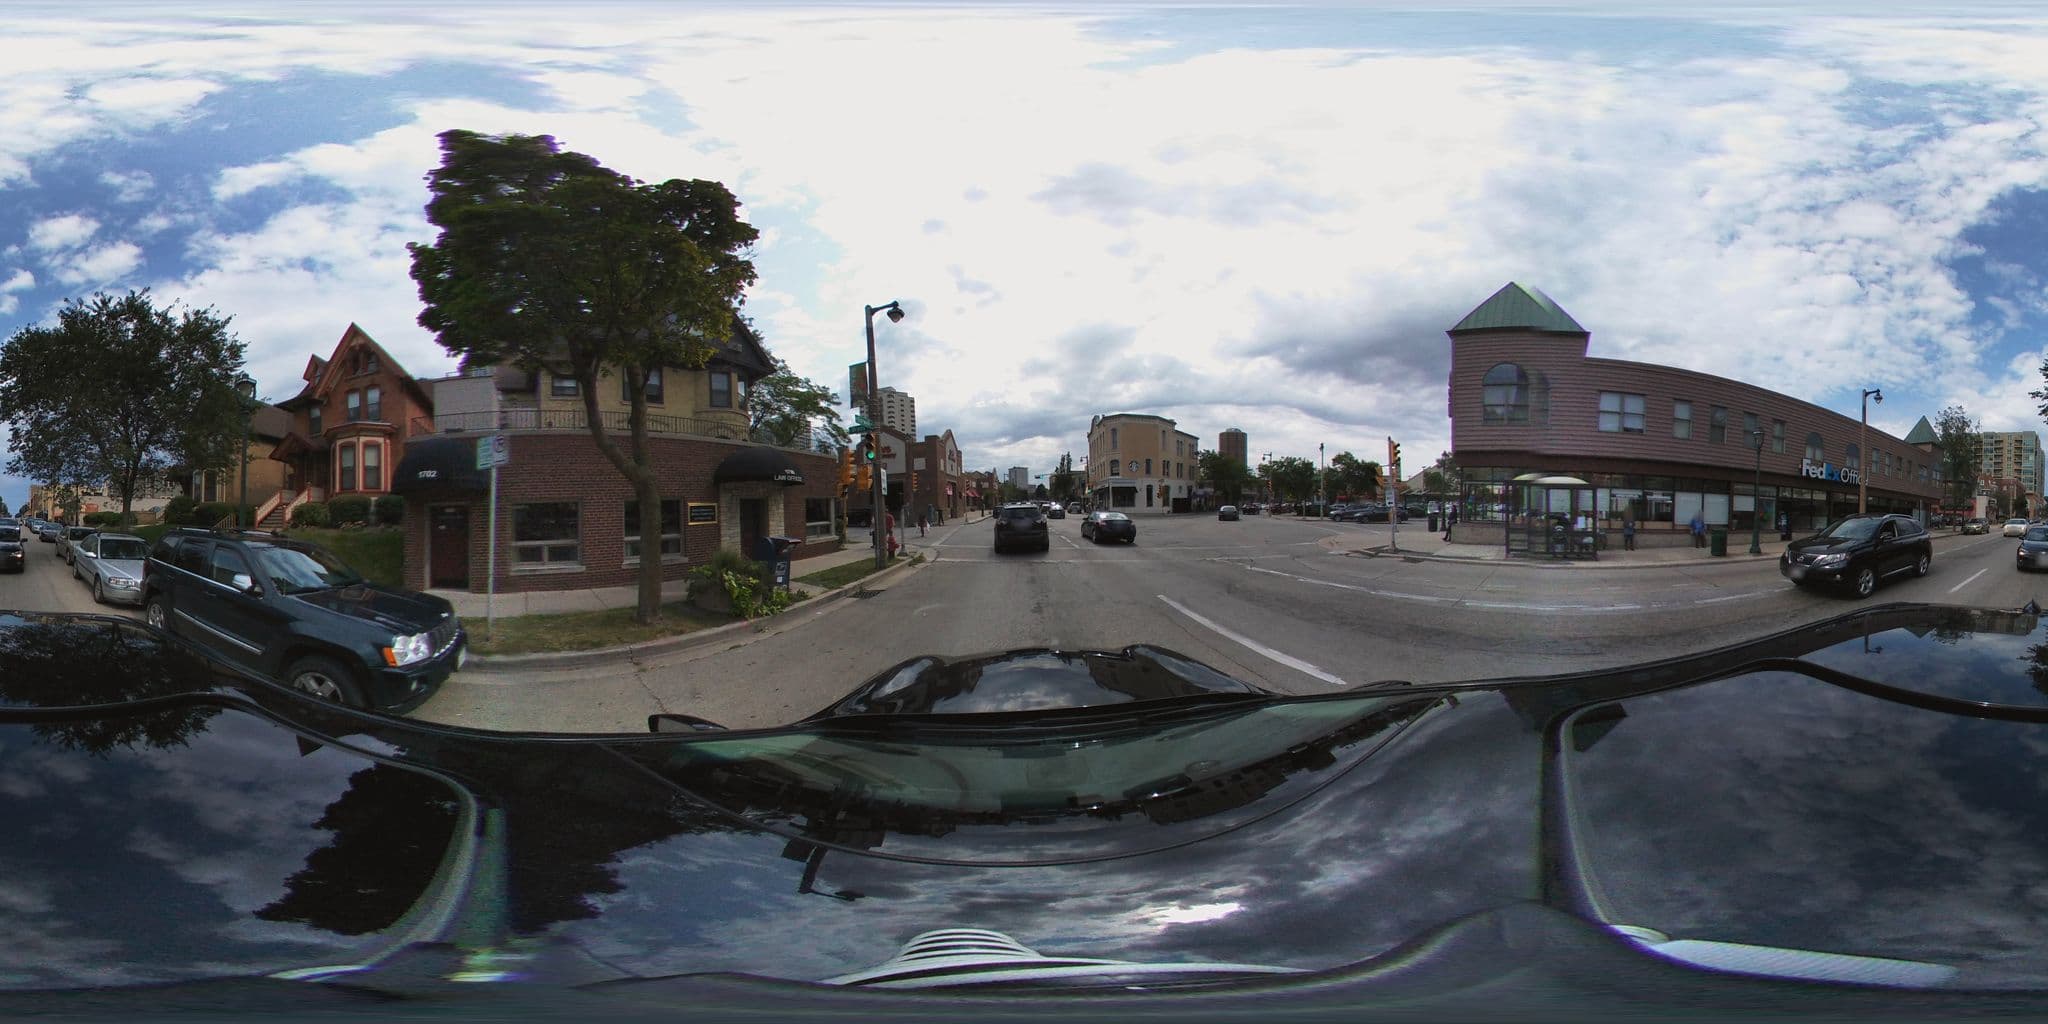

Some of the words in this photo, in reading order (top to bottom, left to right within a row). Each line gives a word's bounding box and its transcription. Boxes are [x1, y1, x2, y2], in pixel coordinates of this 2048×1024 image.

[418, 470, 438, 478] 1702
[1802, 458, 1840, 480] FedEx
[1840, 467, 1868, 485] Offic
